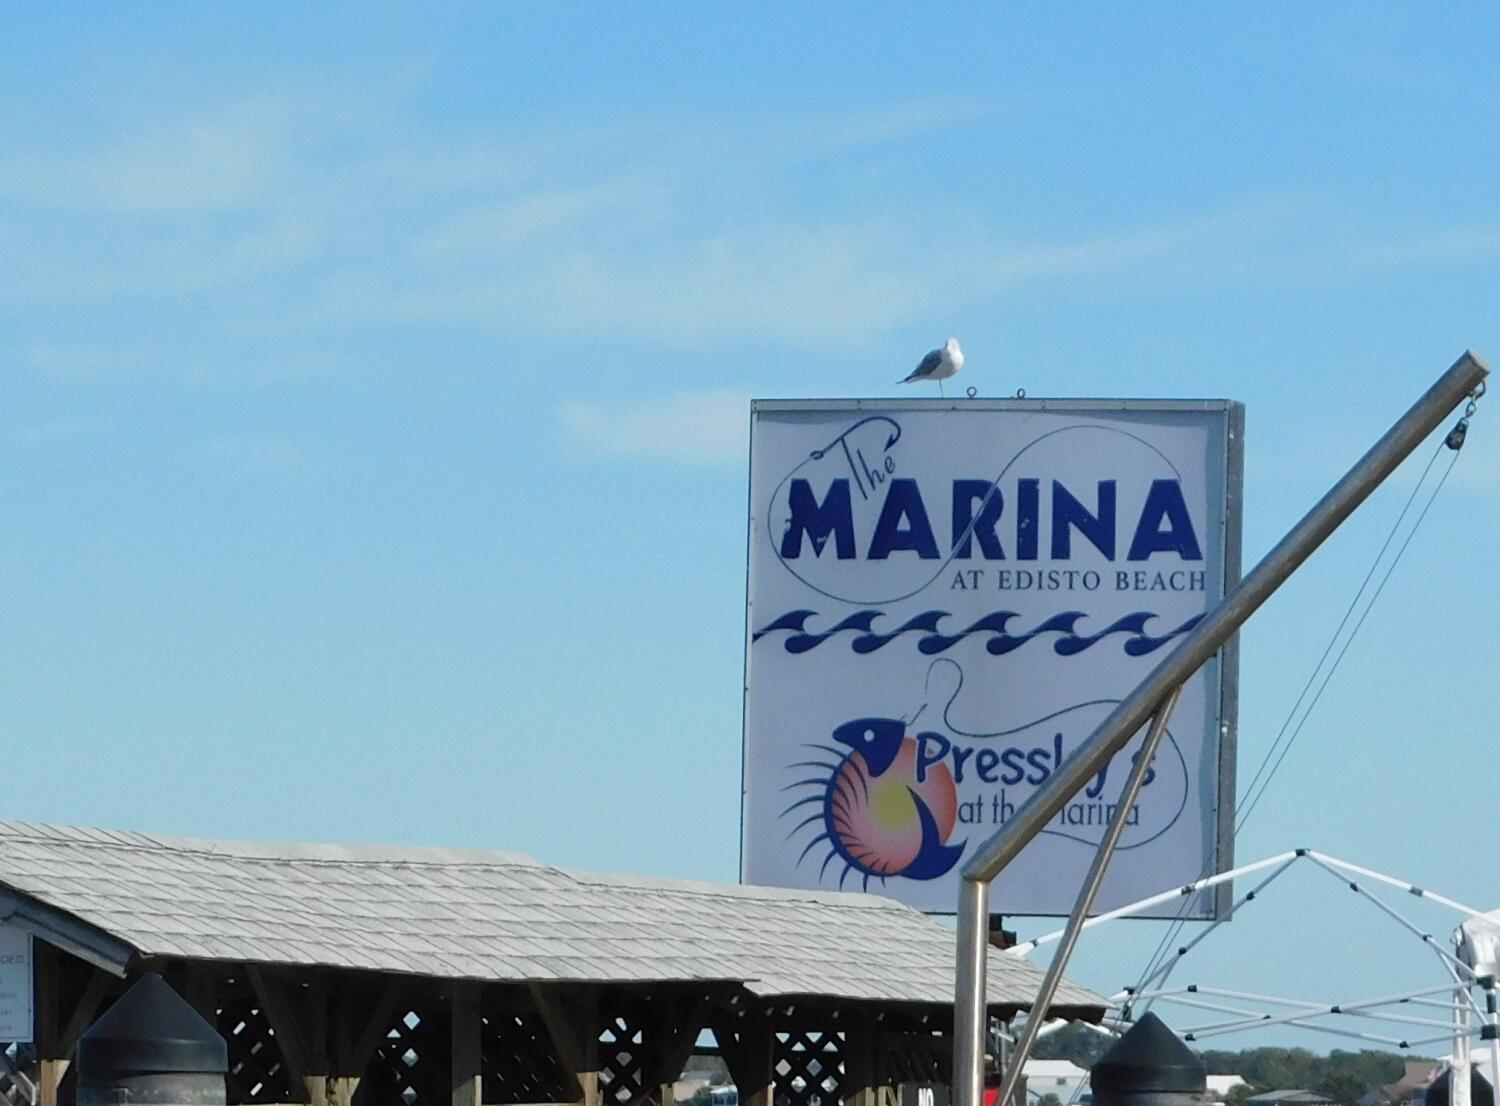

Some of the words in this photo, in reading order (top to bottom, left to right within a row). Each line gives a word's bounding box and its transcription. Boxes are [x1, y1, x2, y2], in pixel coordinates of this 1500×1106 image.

[820, 416, 901, 501] The
[780, 477, 1204, 562] MARINA
[951, 569, 984, 591] AT
[999, 569, 1101, 591] EDISTO
[1115, 569, 1206, 591] BEACH
[957, 794, 983, 825] at
[992, 788, 1016, 825] th
